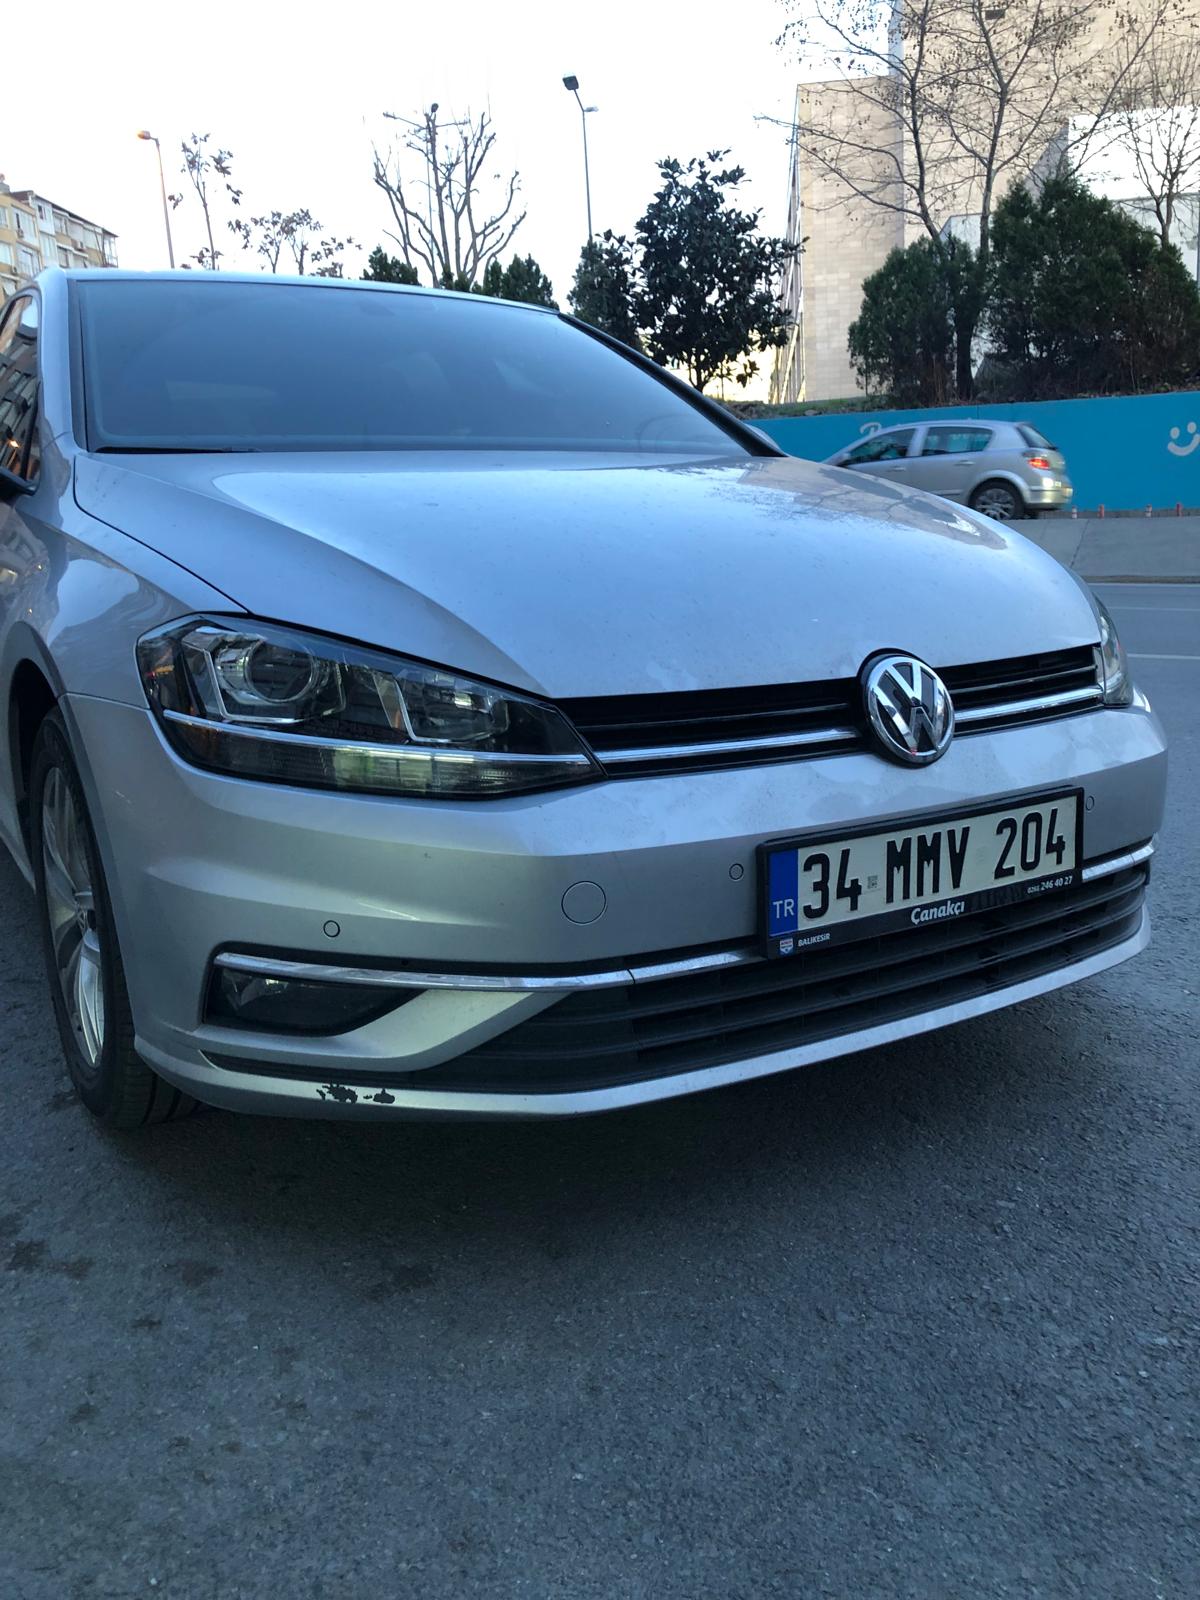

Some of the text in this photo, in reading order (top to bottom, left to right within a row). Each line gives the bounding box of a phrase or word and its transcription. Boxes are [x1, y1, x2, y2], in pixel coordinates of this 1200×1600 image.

[868, 656, 953, 762] VW
[802, 807, 1066, 919] 34 MMV 204
[1054, 877, 1064, 887] 40
[1064, 875, 1073, 885] 27
[772, 898, 795, 919] TR
[911, 900, 965, 925] Çanakçı
